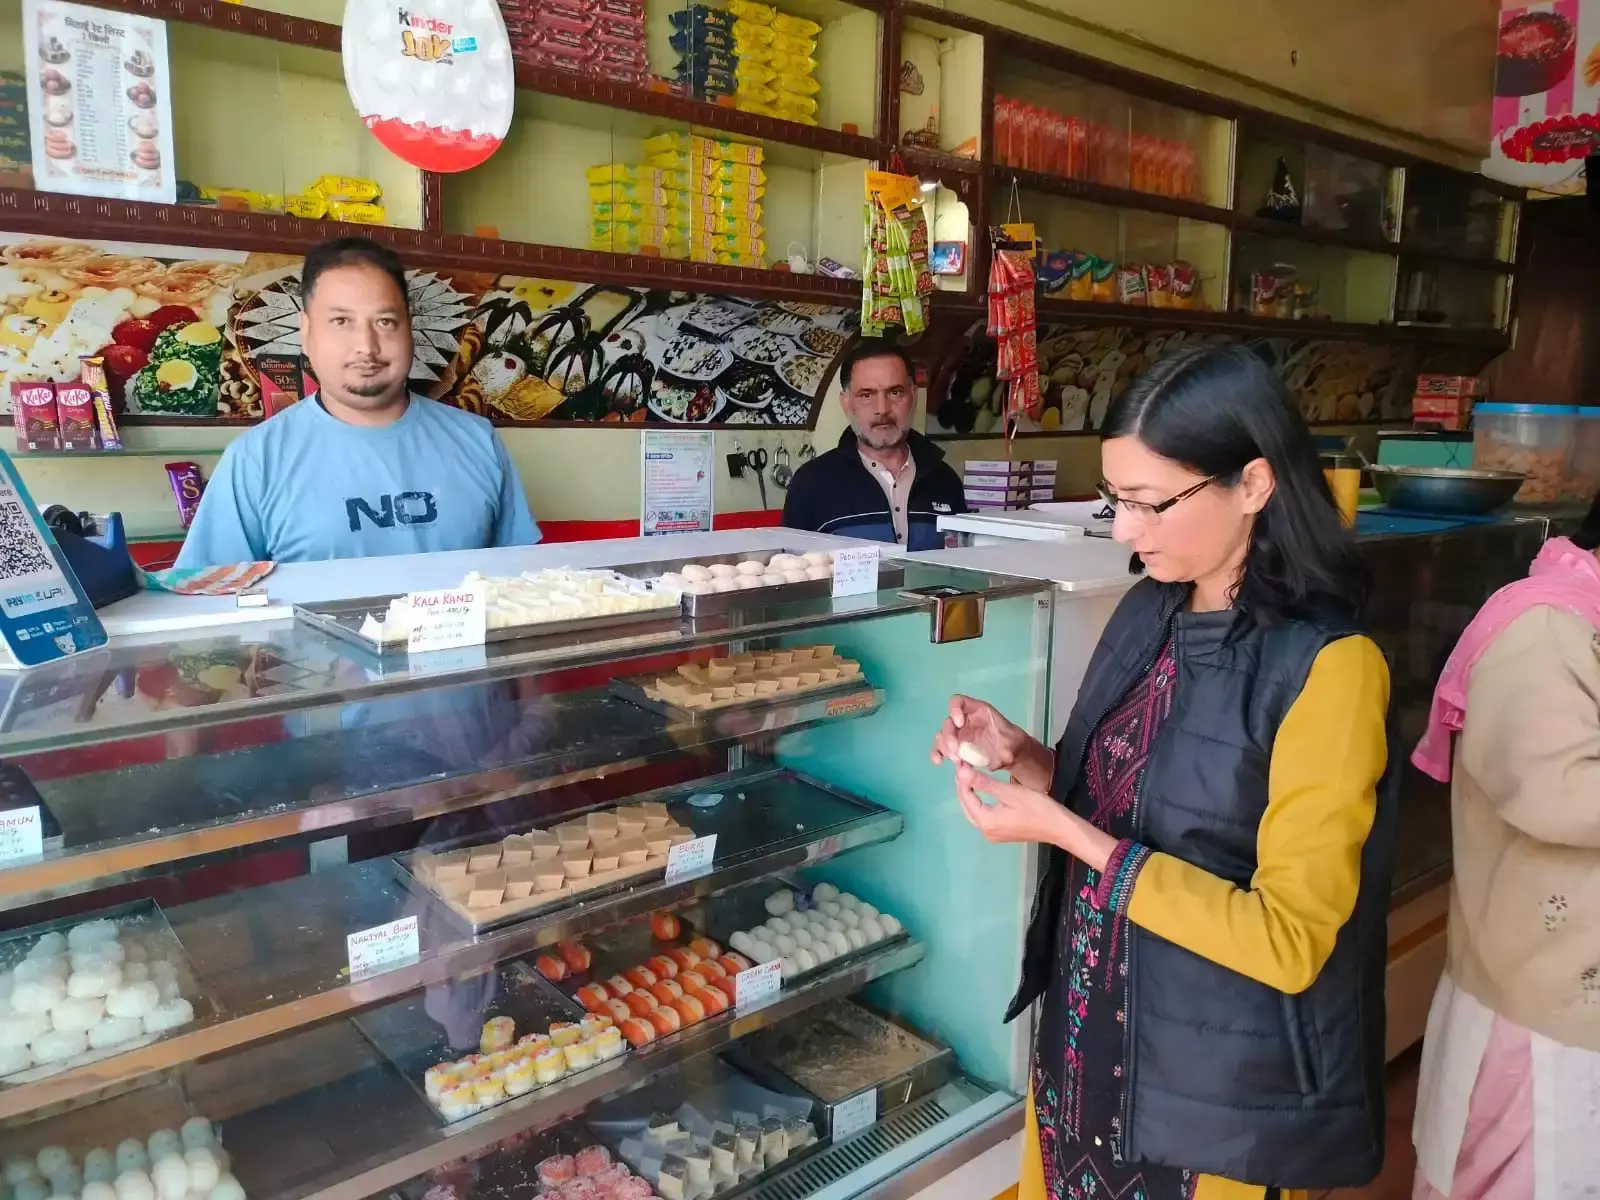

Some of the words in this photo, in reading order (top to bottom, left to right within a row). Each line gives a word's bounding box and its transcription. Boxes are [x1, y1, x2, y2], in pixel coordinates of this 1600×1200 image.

[398, 7, 455, 35] Kinder
[104, 24, 127, 38] लिस्ट
[401, 31, 451, 61] JOY
[261, 361, 297, 369] Bournville
[25, 389, 52, 406] KitKat
[63, 389, 90, 406] KitKat
[345, 491, 438, 532] NO
[412, 595, 440, 608] KALA
[443, 592, 474, 605] KAND
